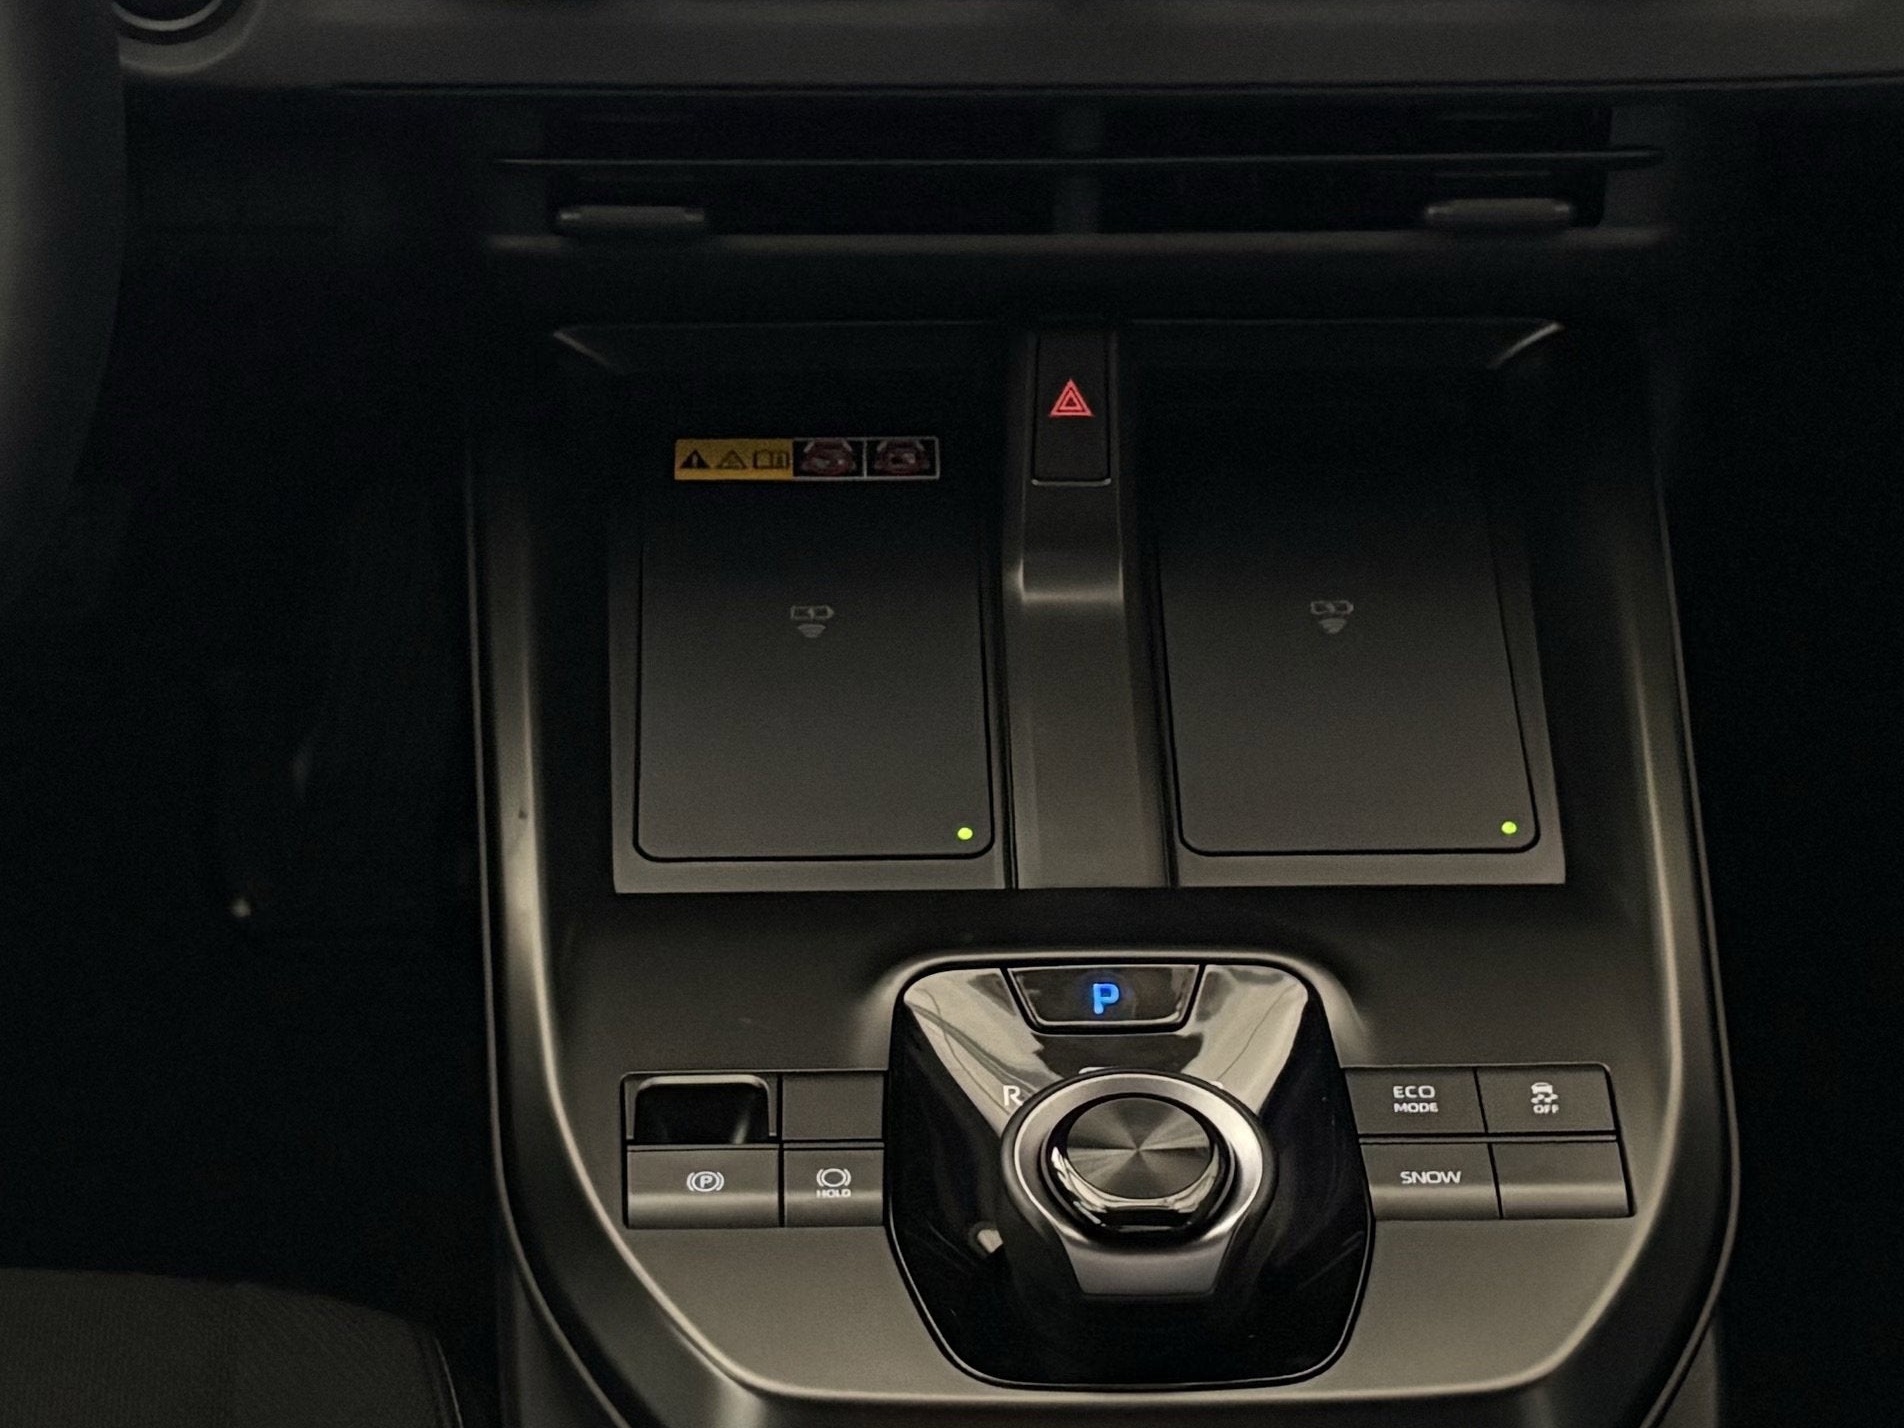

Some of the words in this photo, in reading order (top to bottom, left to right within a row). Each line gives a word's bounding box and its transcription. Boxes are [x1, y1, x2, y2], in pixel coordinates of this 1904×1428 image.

[1091, 981, 1120, 1014] P
[1002, 1084, 1024, 1106] R
[1392, 1085, 1436, 1100] ECO
[1393, 1102, 1439, 1114] MODE
[1532, 1104, 1559, 1114] OFF
[1399, 1170, 1463, 1185] SNOW
[816, 1188, 851, 1199] HOLD
